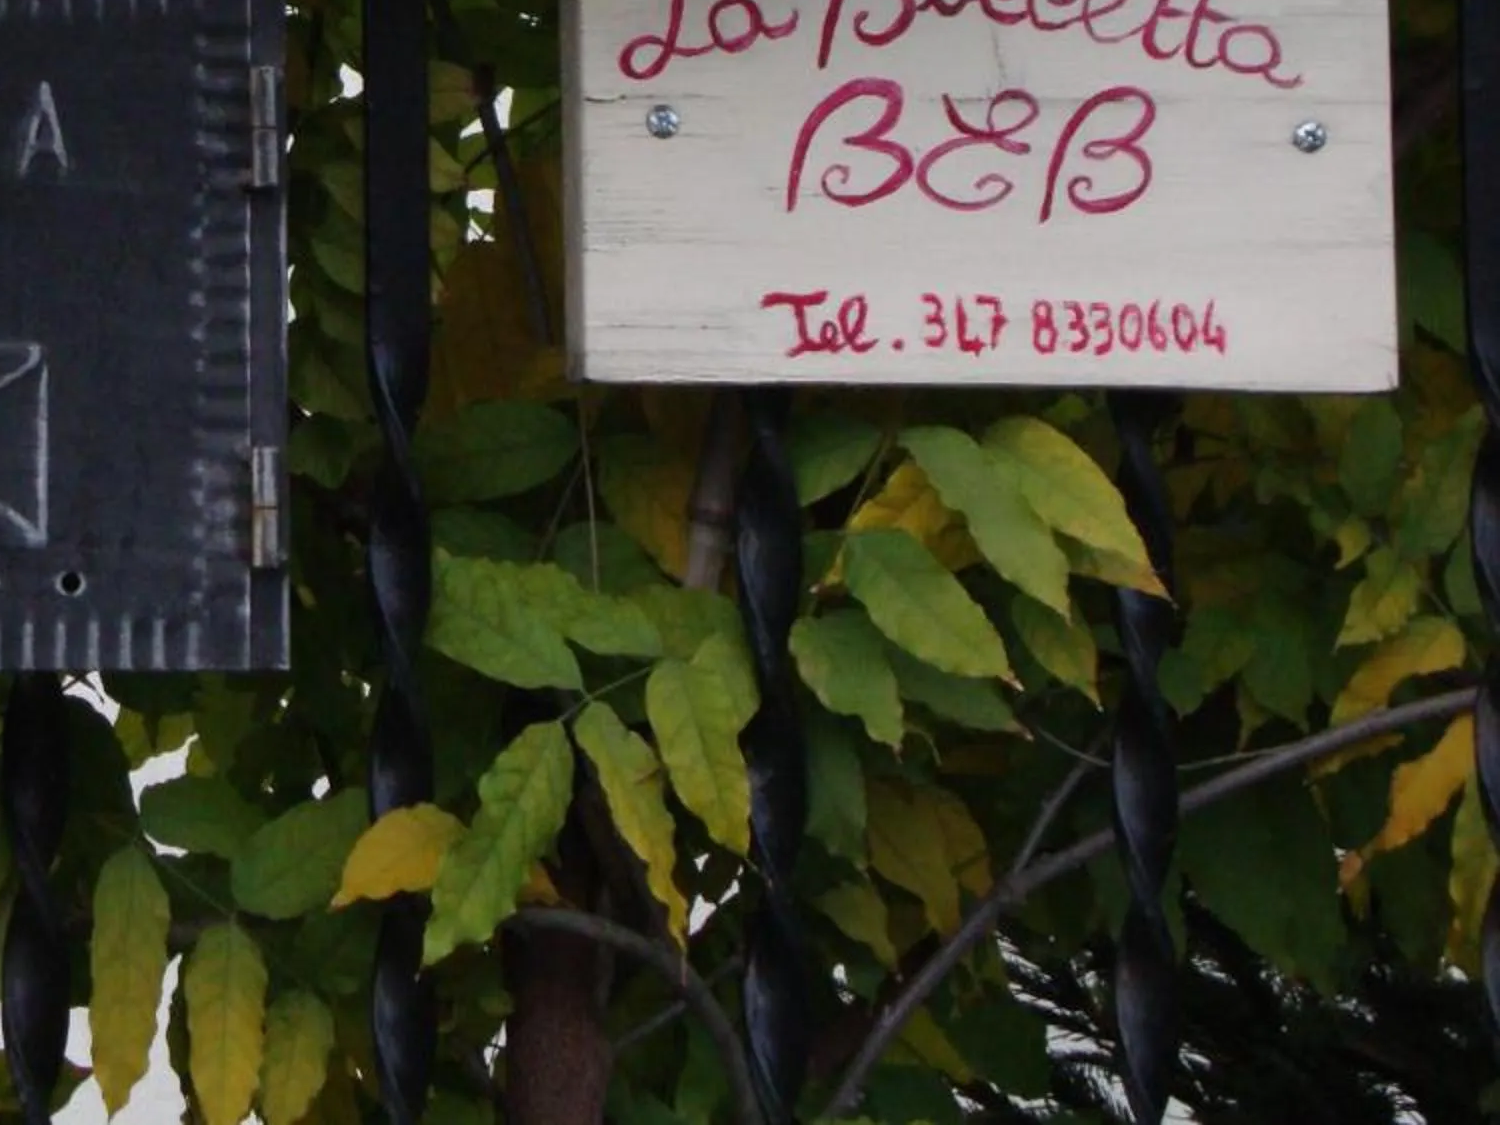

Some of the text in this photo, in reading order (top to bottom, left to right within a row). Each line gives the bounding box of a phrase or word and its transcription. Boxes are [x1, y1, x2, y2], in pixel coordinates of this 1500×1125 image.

[760, 290, 1228, 358] Tel. 347 8330604
